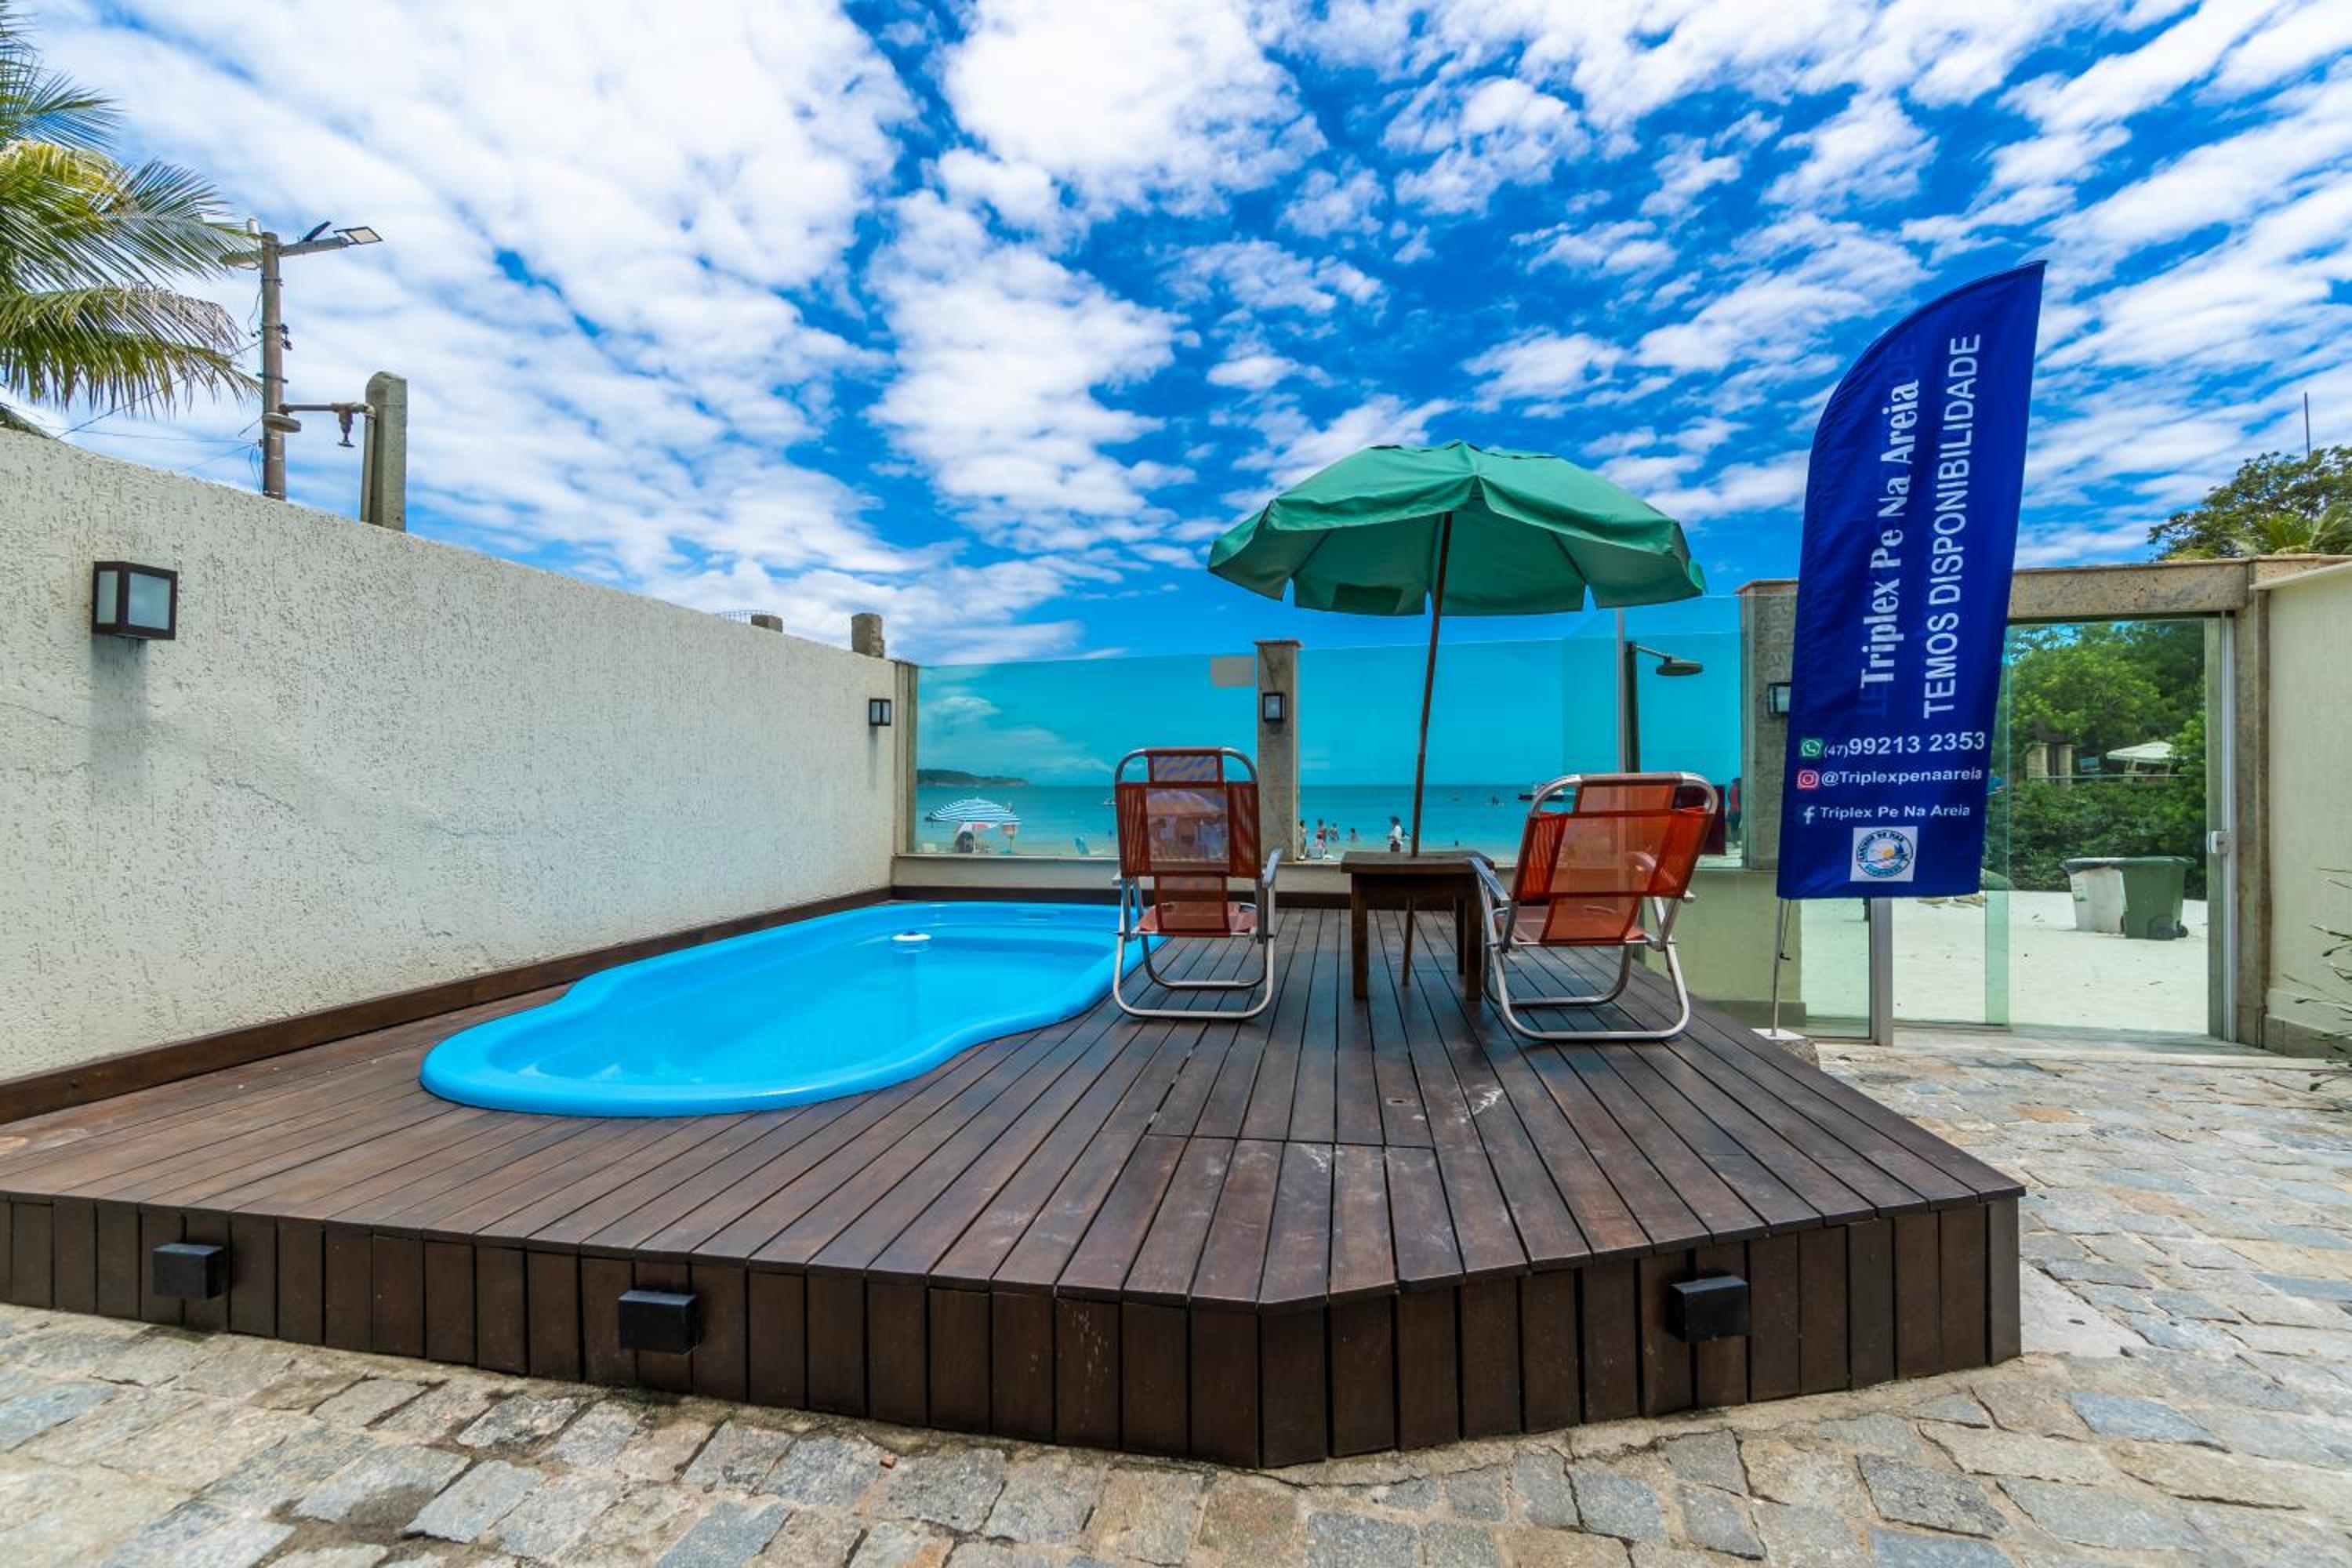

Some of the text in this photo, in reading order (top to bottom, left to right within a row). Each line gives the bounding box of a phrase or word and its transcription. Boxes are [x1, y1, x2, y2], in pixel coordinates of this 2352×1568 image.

[1881, 379, 1919, 464] Areia
[1878, 476, 1911, 517] Na
[1923, 335, 1981, 719] TEMOS DISPONIBILIDADE
[1871, 530, 1903, 568] Pe
[1860, 579, 1904, 688] Triplex
[1929, 731, 1985, 752] 2353
[1821, 767, 1983, 786] @Triplexpenaareia
[1820, 807, 1872, 820] Triplex
[1877, 806, 1899, 818] Pe
[1904, 805, 1926, 817] Na
[1930, 804, 1970, 817] Areia
